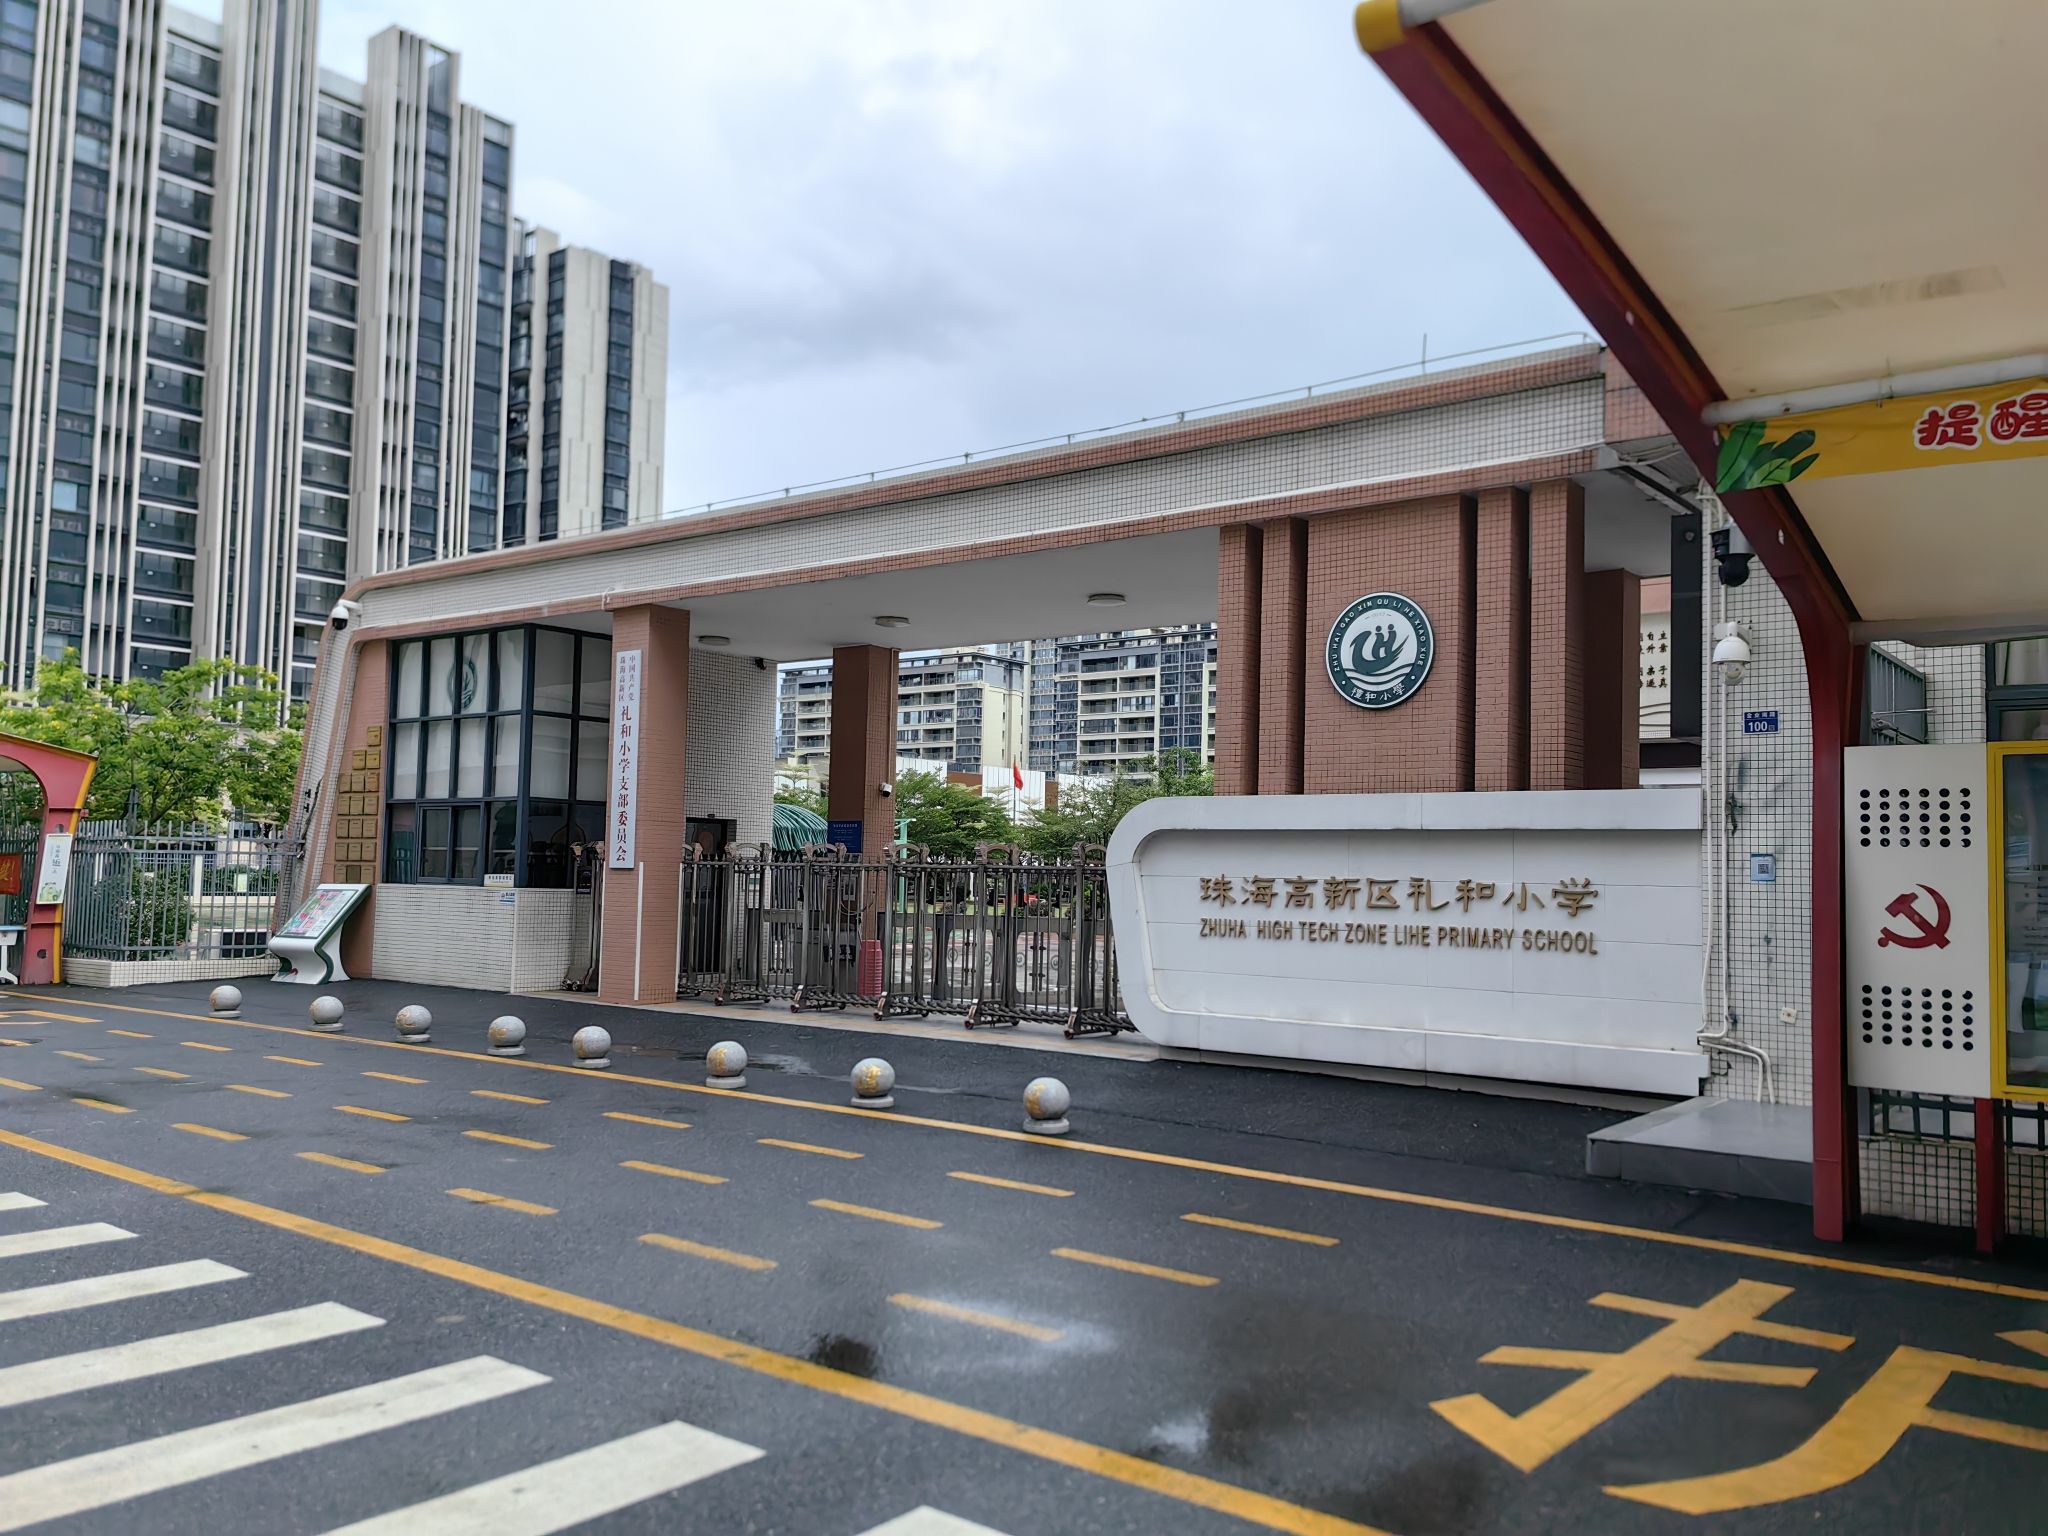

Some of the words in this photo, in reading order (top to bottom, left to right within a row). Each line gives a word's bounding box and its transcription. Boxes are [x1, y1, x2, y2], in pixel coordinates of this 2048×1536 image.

[1357, 601, 1373, 611] XIN
[1393, 600, 1401, 608] LI
[1404, 607, 1415, 618] HE
[1415, 619, 1426, 642] XIAO
[616, 705, 632, 862] 礼和小学支部委员会
[1200, 873, 1599, 917] 珠海高新区礼和小学
[1200, 918, 1247, 938] ZHUHA
[1257, 919, 1293, 940] HIGH
[1299, 921, 1339, 942] TECH
[1344, 922, 1388, 945] ZONE
[1394, 924, 1431, 947] LIHE
[1437, 926, 1514, 950] PRIMARY
[1522, 928, 1598, 955] SCHOOL
